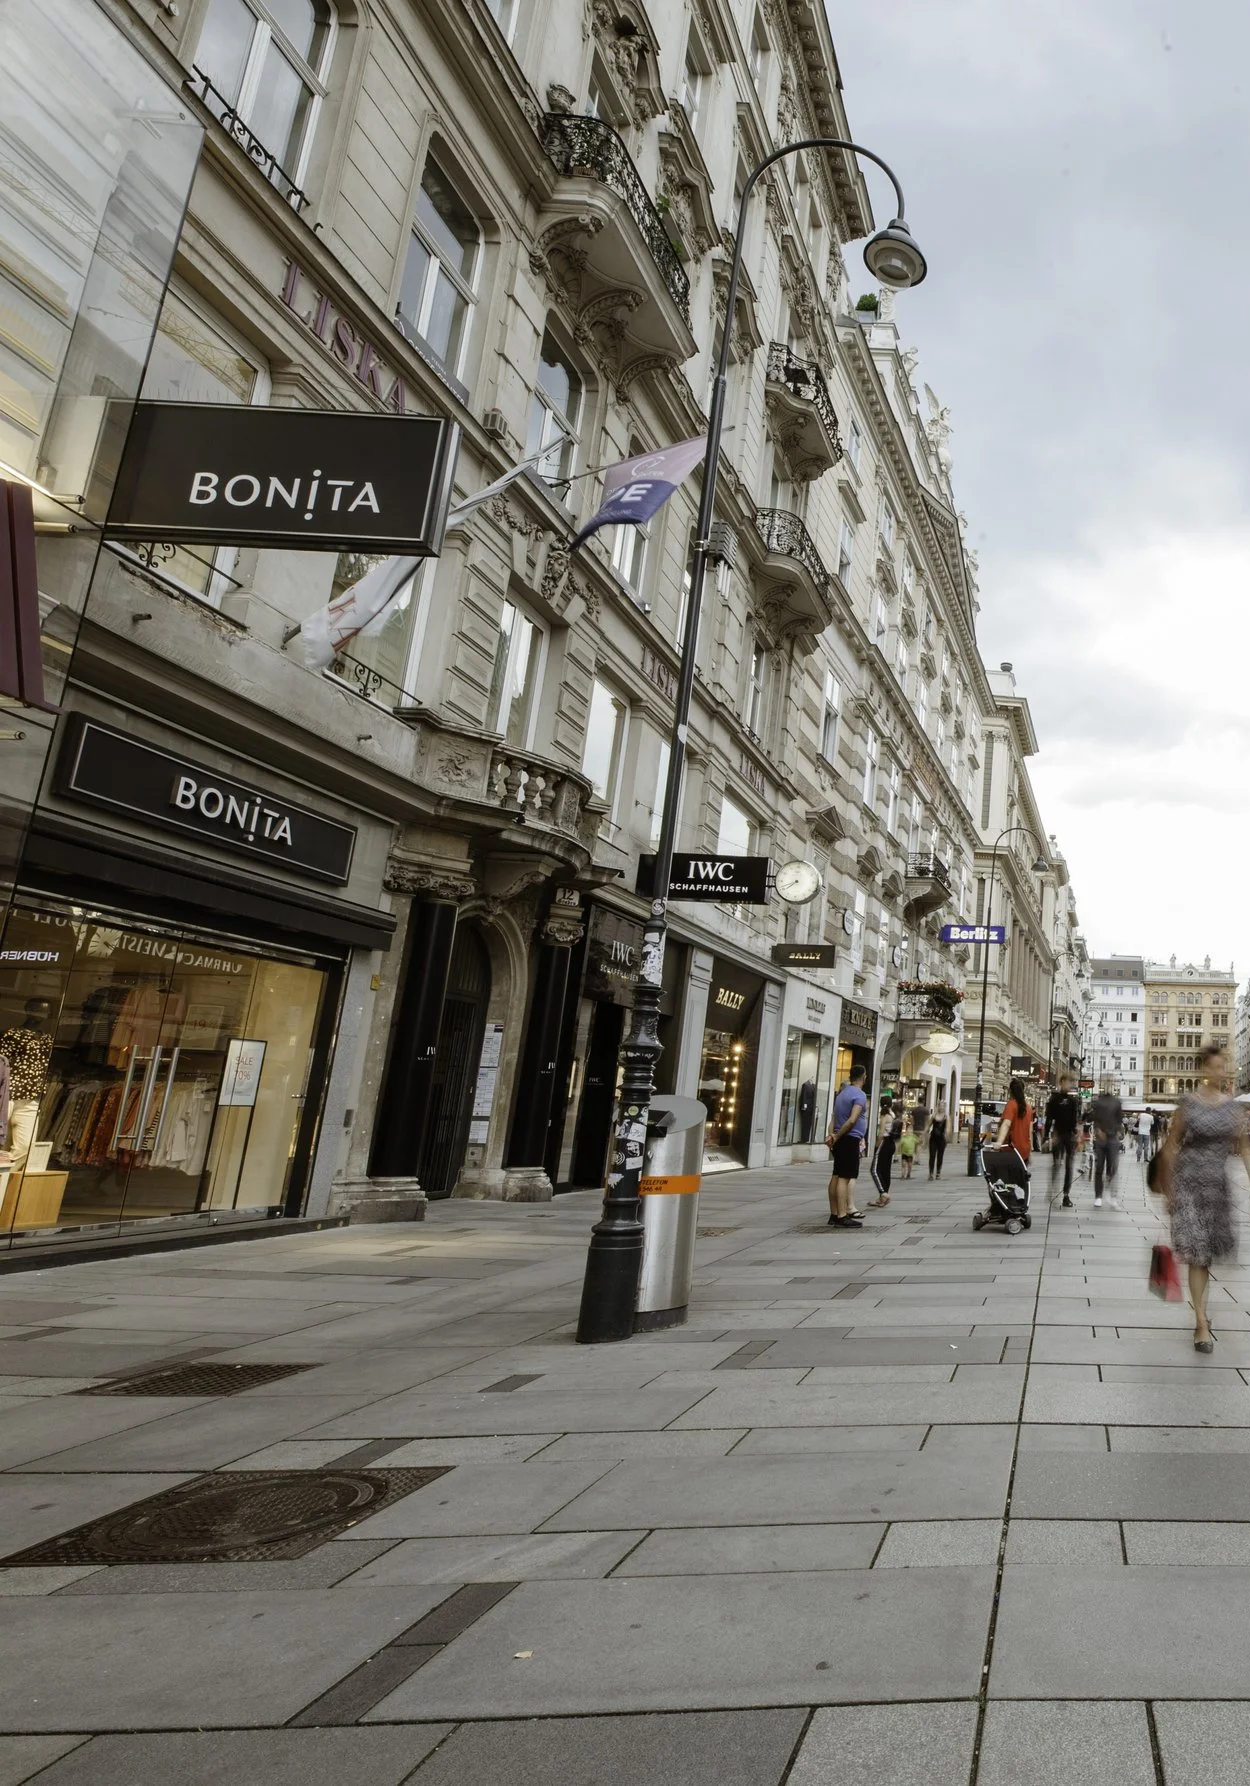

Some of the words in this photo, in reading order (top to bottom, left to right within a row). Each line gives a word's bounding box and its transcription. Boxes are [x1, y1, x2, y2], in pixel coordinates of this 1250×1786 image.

[278, 257, 405, 413] LISKA
[687, 860, 735, 881] IWC
[563, 889, 574, 900] 12
[669, 883, 749, 893] SCHAFFHAUSEN
[950, 927, 998, 940] Berlitz
[611, 940, 635, 966] IWC
[715, 987, 745, 1010] BALLY
[235, 1056, 254, 1066] SALE
